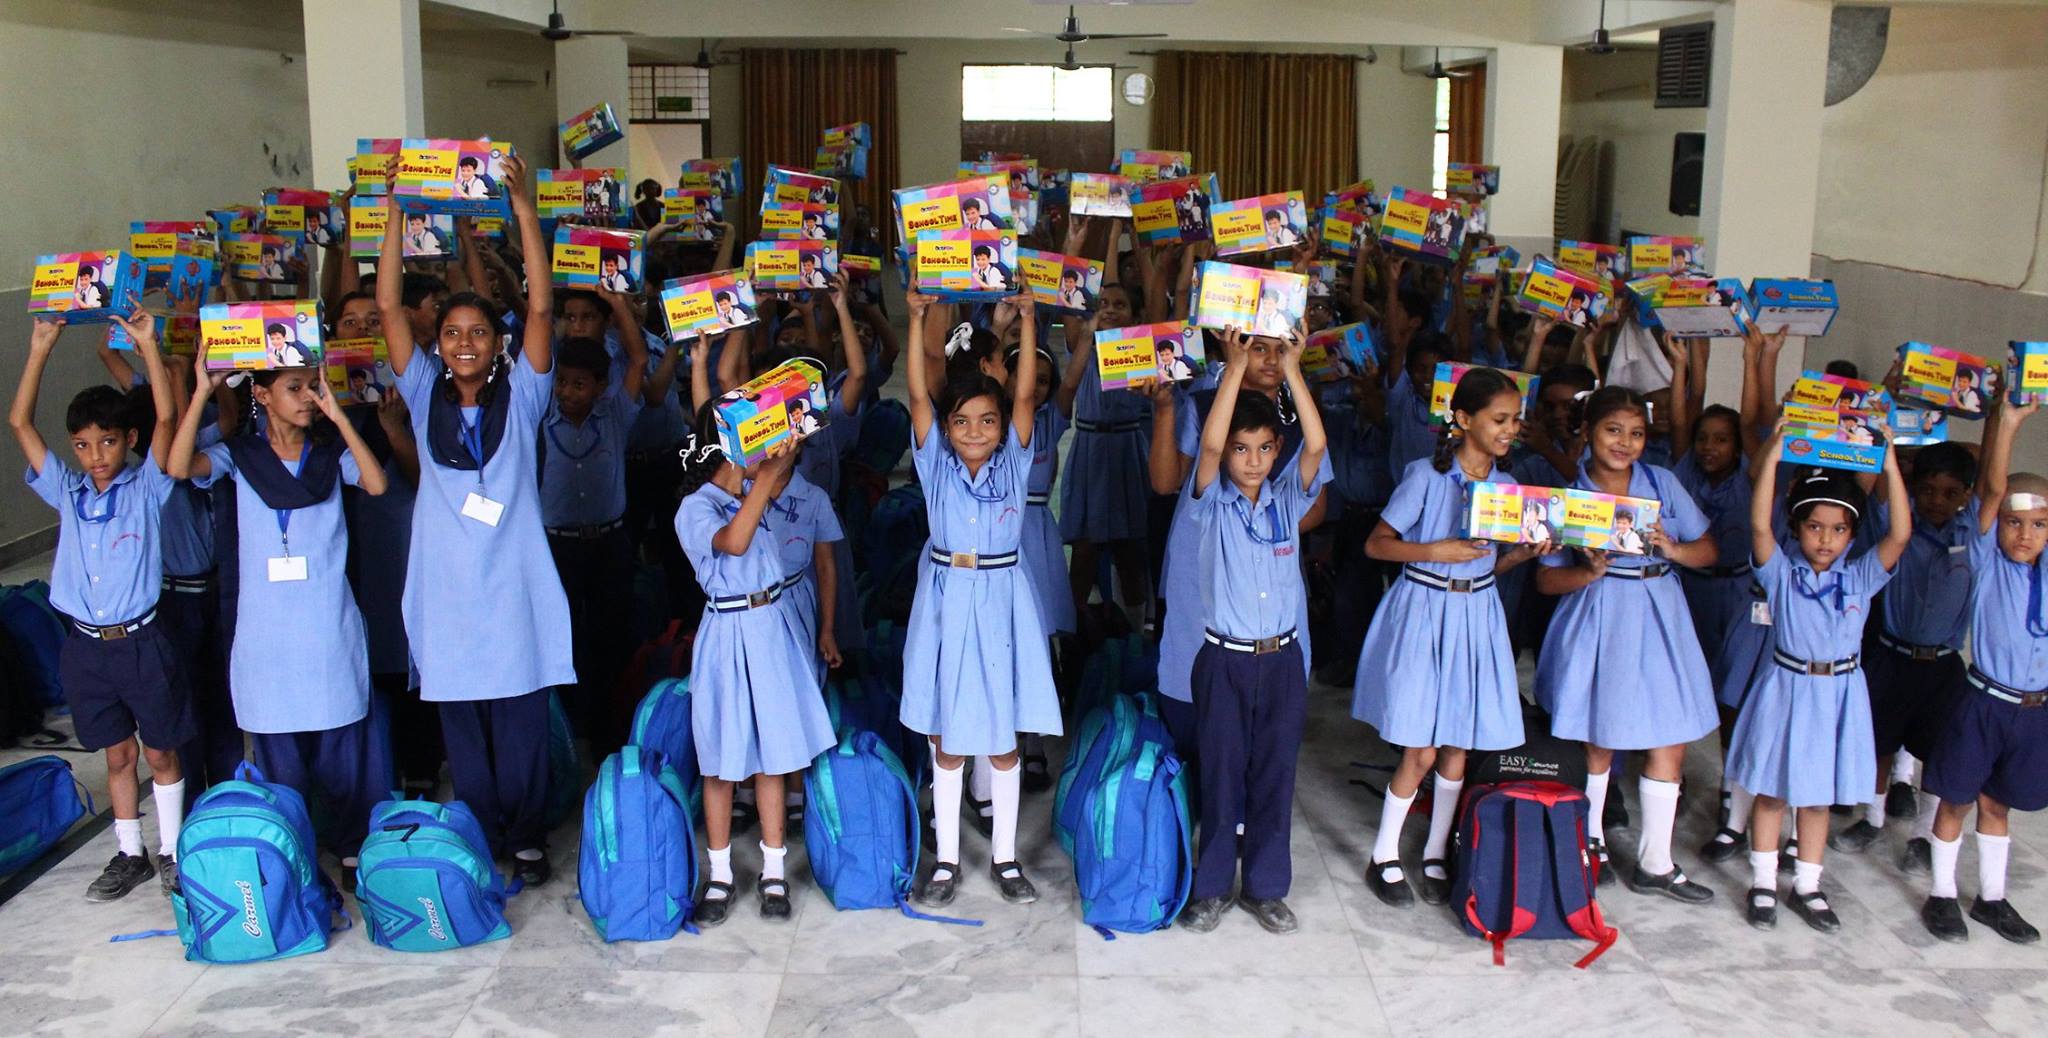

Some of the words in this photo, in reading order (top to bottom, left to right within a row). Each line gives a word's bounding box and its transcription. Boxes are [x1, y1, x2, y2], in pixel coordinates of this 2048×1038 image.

[403, 164, 432, 174] SCHOOL
[433, 166, 452, 175] TIME
[908, 218, 938, 229] SCHOOL
[938, 214, 958, 222] TIME
[1218, 226, 1246, 236] SCHOOL
[1246, 223, 1260, 232] TIME
[758, 262, 782, 270] SCHOOL
[782, 262, 797, 270] TIME
[920, 256, 950, 264] SCHOOL
[950, 256, 968, 264] TIME
[672, 310, 697, 320] SCHOOL
[698, 305, 713, 314] TIME
[208, 336, 238, 346] SCHOOL
[240, 336, 261, 346] TIME
[1104, 356, 1134, 366] SCHOOL
[1133, 354, 1152, 362] TIME
[744, 429, 770, 444] SCHOOL
[770, 419, 786, 432] TIME
[1820, 449, 1854, 462] SCHOOL
[1856, 454, 1876, 465] TIME
[1500, 754, 1527, 766] EASY
[235, 880, 262, 938] Carmel
[417, 896, 448, 942] Carmel
